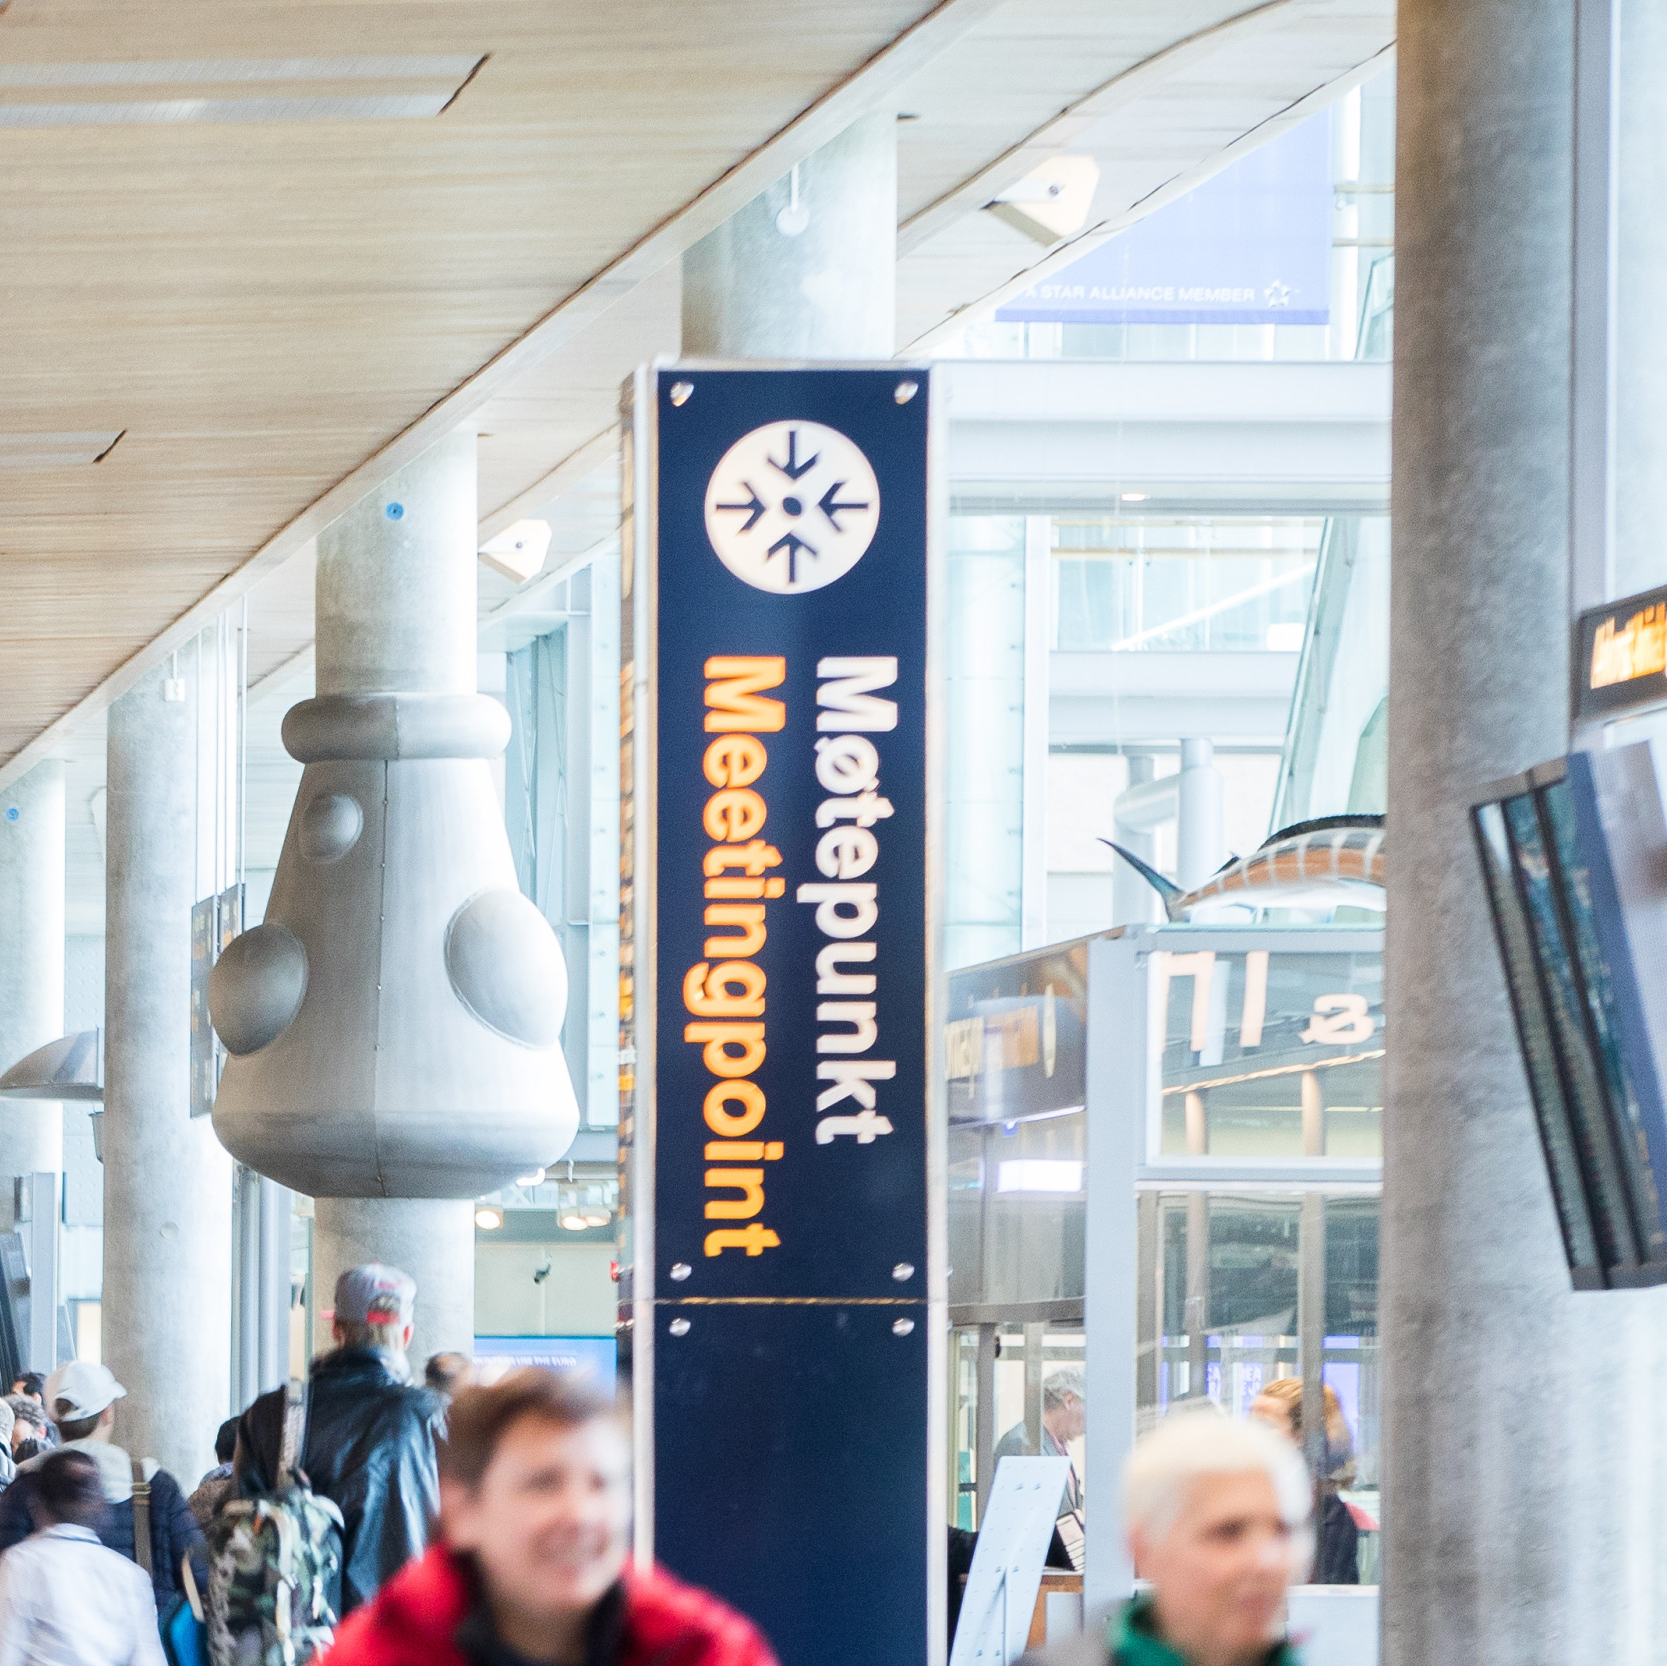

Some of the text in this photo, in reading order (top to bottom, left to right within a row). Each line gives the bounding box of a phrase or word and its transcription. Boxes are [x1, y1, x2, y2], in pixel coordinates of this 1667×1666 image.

[1041, 285, 1087, 300] STAR
[1088, 286, 1175, 302] ALLIANCE
[1179, 287, 1255, 303] MEMBER
[683, 655, 787, 1258] Meetingpoint
[796, 655, 899, 1146] Møtepunkt
